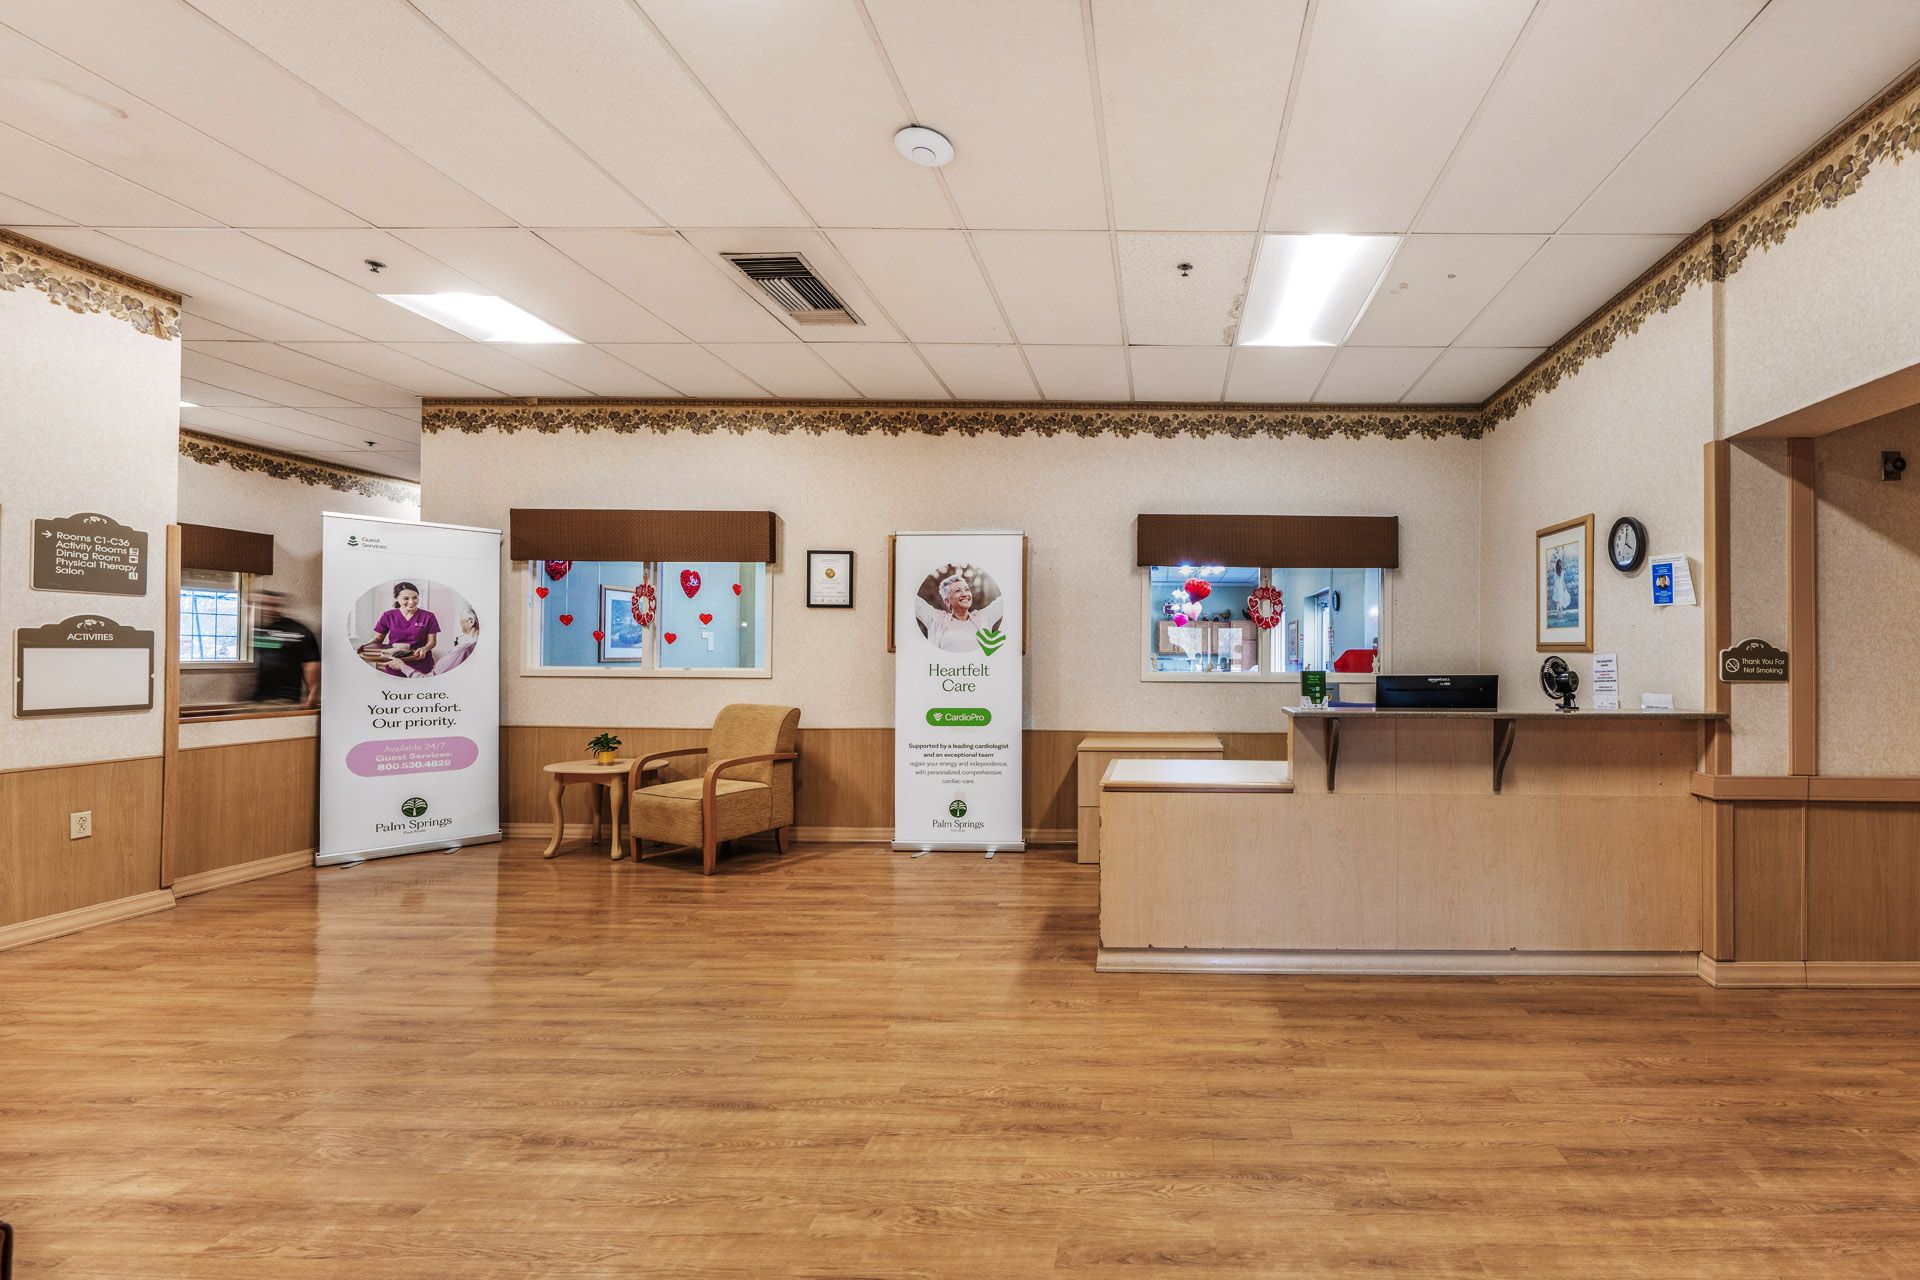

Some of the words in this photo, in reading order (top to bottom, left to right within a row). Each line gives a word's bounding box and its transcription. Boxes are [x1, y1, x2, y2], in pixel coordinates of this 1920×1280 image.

[56, 531, 91, 542] Rooms
[94, 536, 130, 547] C1-C36
[56, 541, 92, 552] Activity
[95, 544, 128, 555] Rooms
[56, 549, 89, 560] Dining
[92, 552, 121, 562] Room
[55, 566, 85, 576] Salon
[56, 557, 97, 568] Physical
[99, 561, 137, 573] Therapy
[67, 633, 114, 641] ACTIVITIES
[929, 662, 991, 677] Heartfelt
[1755, 667, 1784, 675] Smoking
[942, 678, 976, 692] Care
[381, 690, 414, 701] Your
[416, 692, 449, 700] care.
[367, 704, 401, 715] Your
[403, 702, 461, 714] comfort.
[372, 718, 402, 729] Our
[405, 716, 457, 730] priority.
[944, 713, 985, 722] CardioPro
[384, 743, 422, 753] Available
[424, 742, 446, 751] 24/7
[375, 754, 407, 762] Guest
[375, 822, 406, 833] Palm
[408, 817, 453, 830] Springs
[932, 819, 952, 828] Palm
[953, 819, 985, 830] Springs
